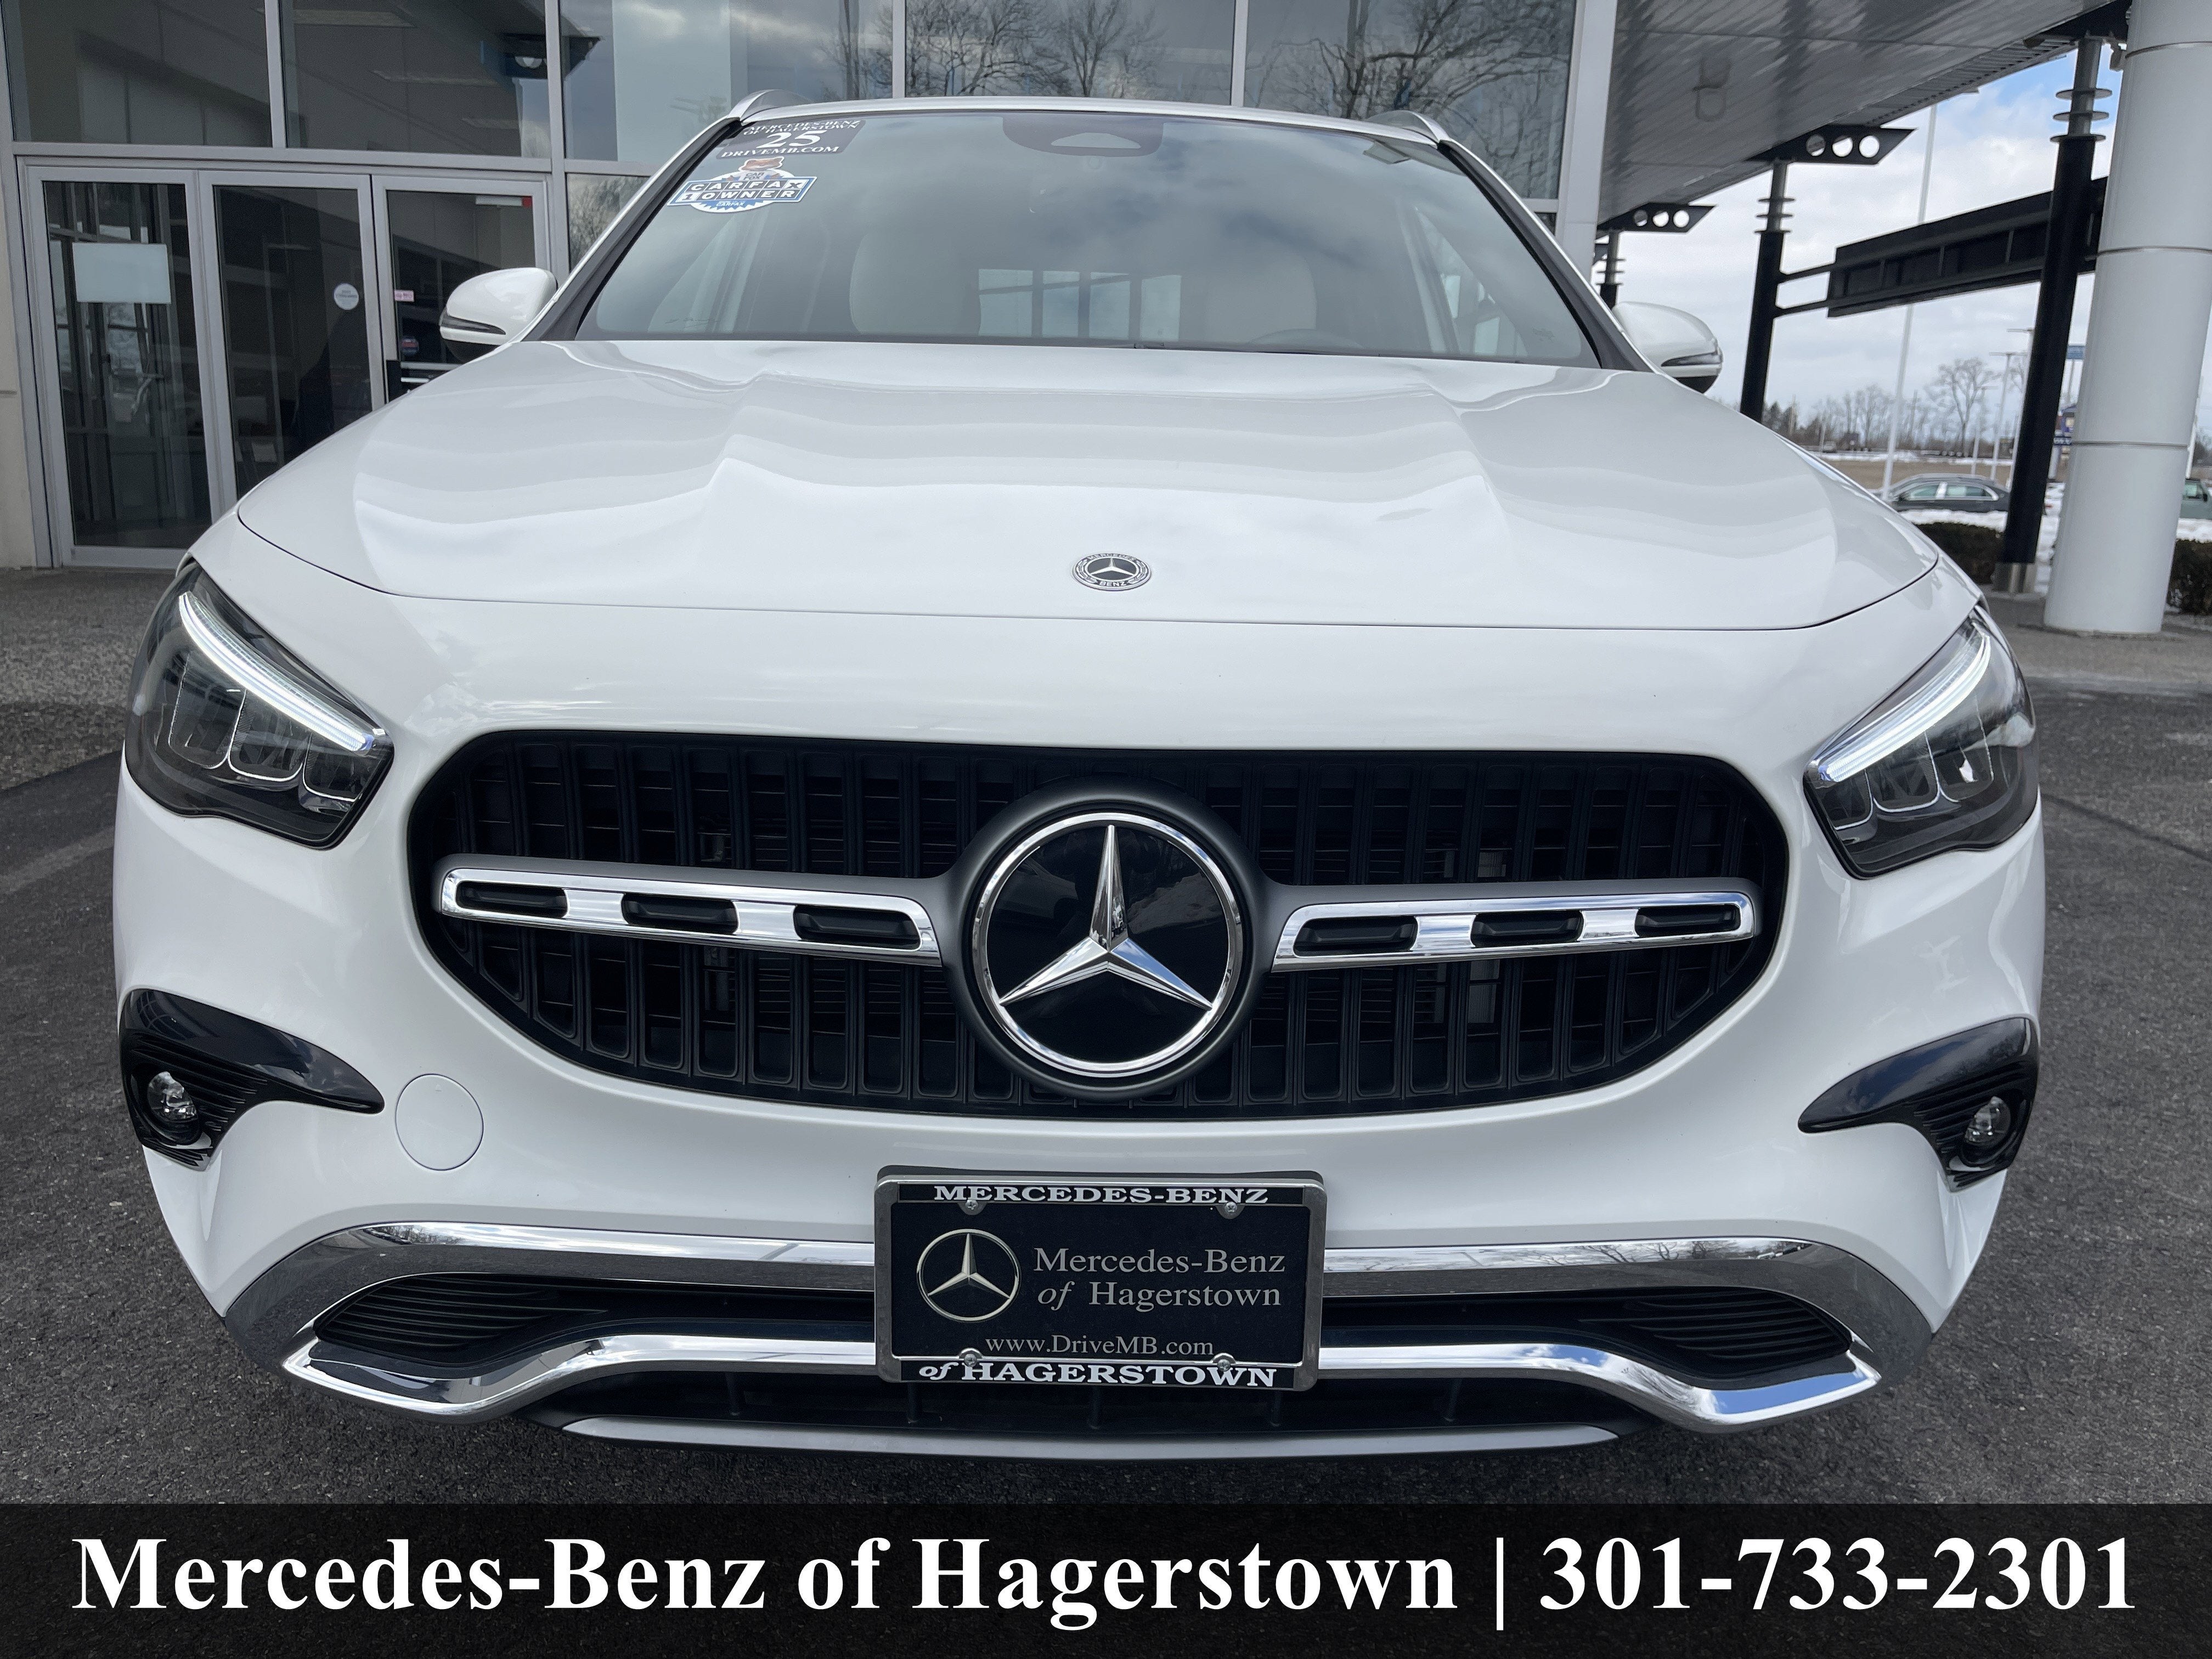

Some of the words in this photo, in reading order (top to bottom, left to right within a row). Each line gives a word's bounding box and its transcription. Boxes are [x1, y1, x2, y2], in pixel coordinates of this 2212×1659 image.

[755, 130, 827, 149] 25
[721, 146, 839, 157] DRIVEMB.COM
[682, 193, 695, 201] 1
[701, 190, 793, 200] OWNER
[691, 181, 803, 191] CARFAX
[934, 1185, 1268, 1204] MERCEDES-BENZ
[1033, 1247, 1285, 1273] Mercedes-Benz
[1038, 1281, 1074, 1311] of
[1091, 1282, 1281, 1312] Hagerstown
[985, 1334, 1214, 1357] www.DriveMB.com
[919, 1363, 959, 1381] of
[961, 1362, 1275, 1387] HAGERSTOWN
